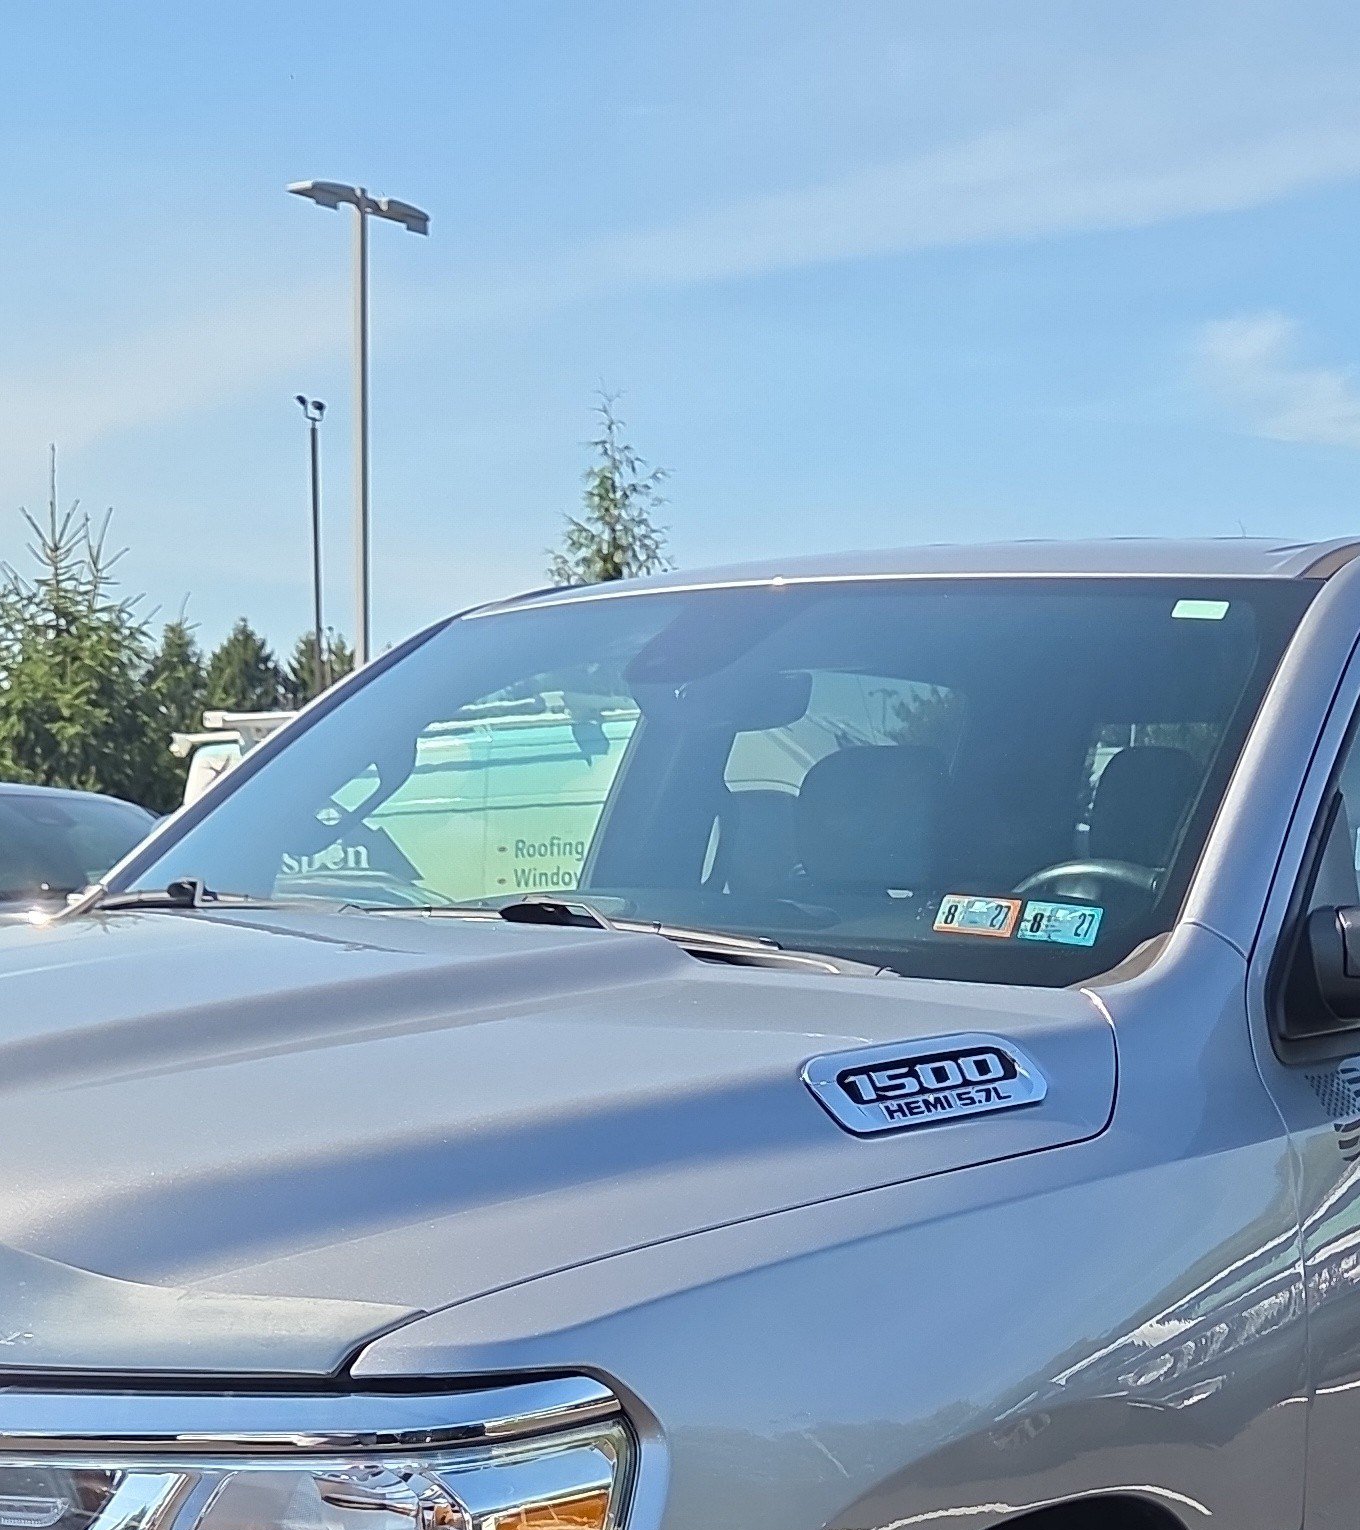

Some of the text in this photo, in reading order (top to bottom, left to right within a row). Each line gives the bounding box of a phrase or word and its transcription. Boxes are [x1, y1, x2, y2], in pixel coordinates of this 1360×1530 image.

[515, 836, 585, 861] Roofing
[989, 904, 1012, 930] 27
[1073, 912, 1096, 938] 27
[844, 1053, 1006, 1101] 1500
[882, 1087, 1012, 1121] HEMI 5.7L
